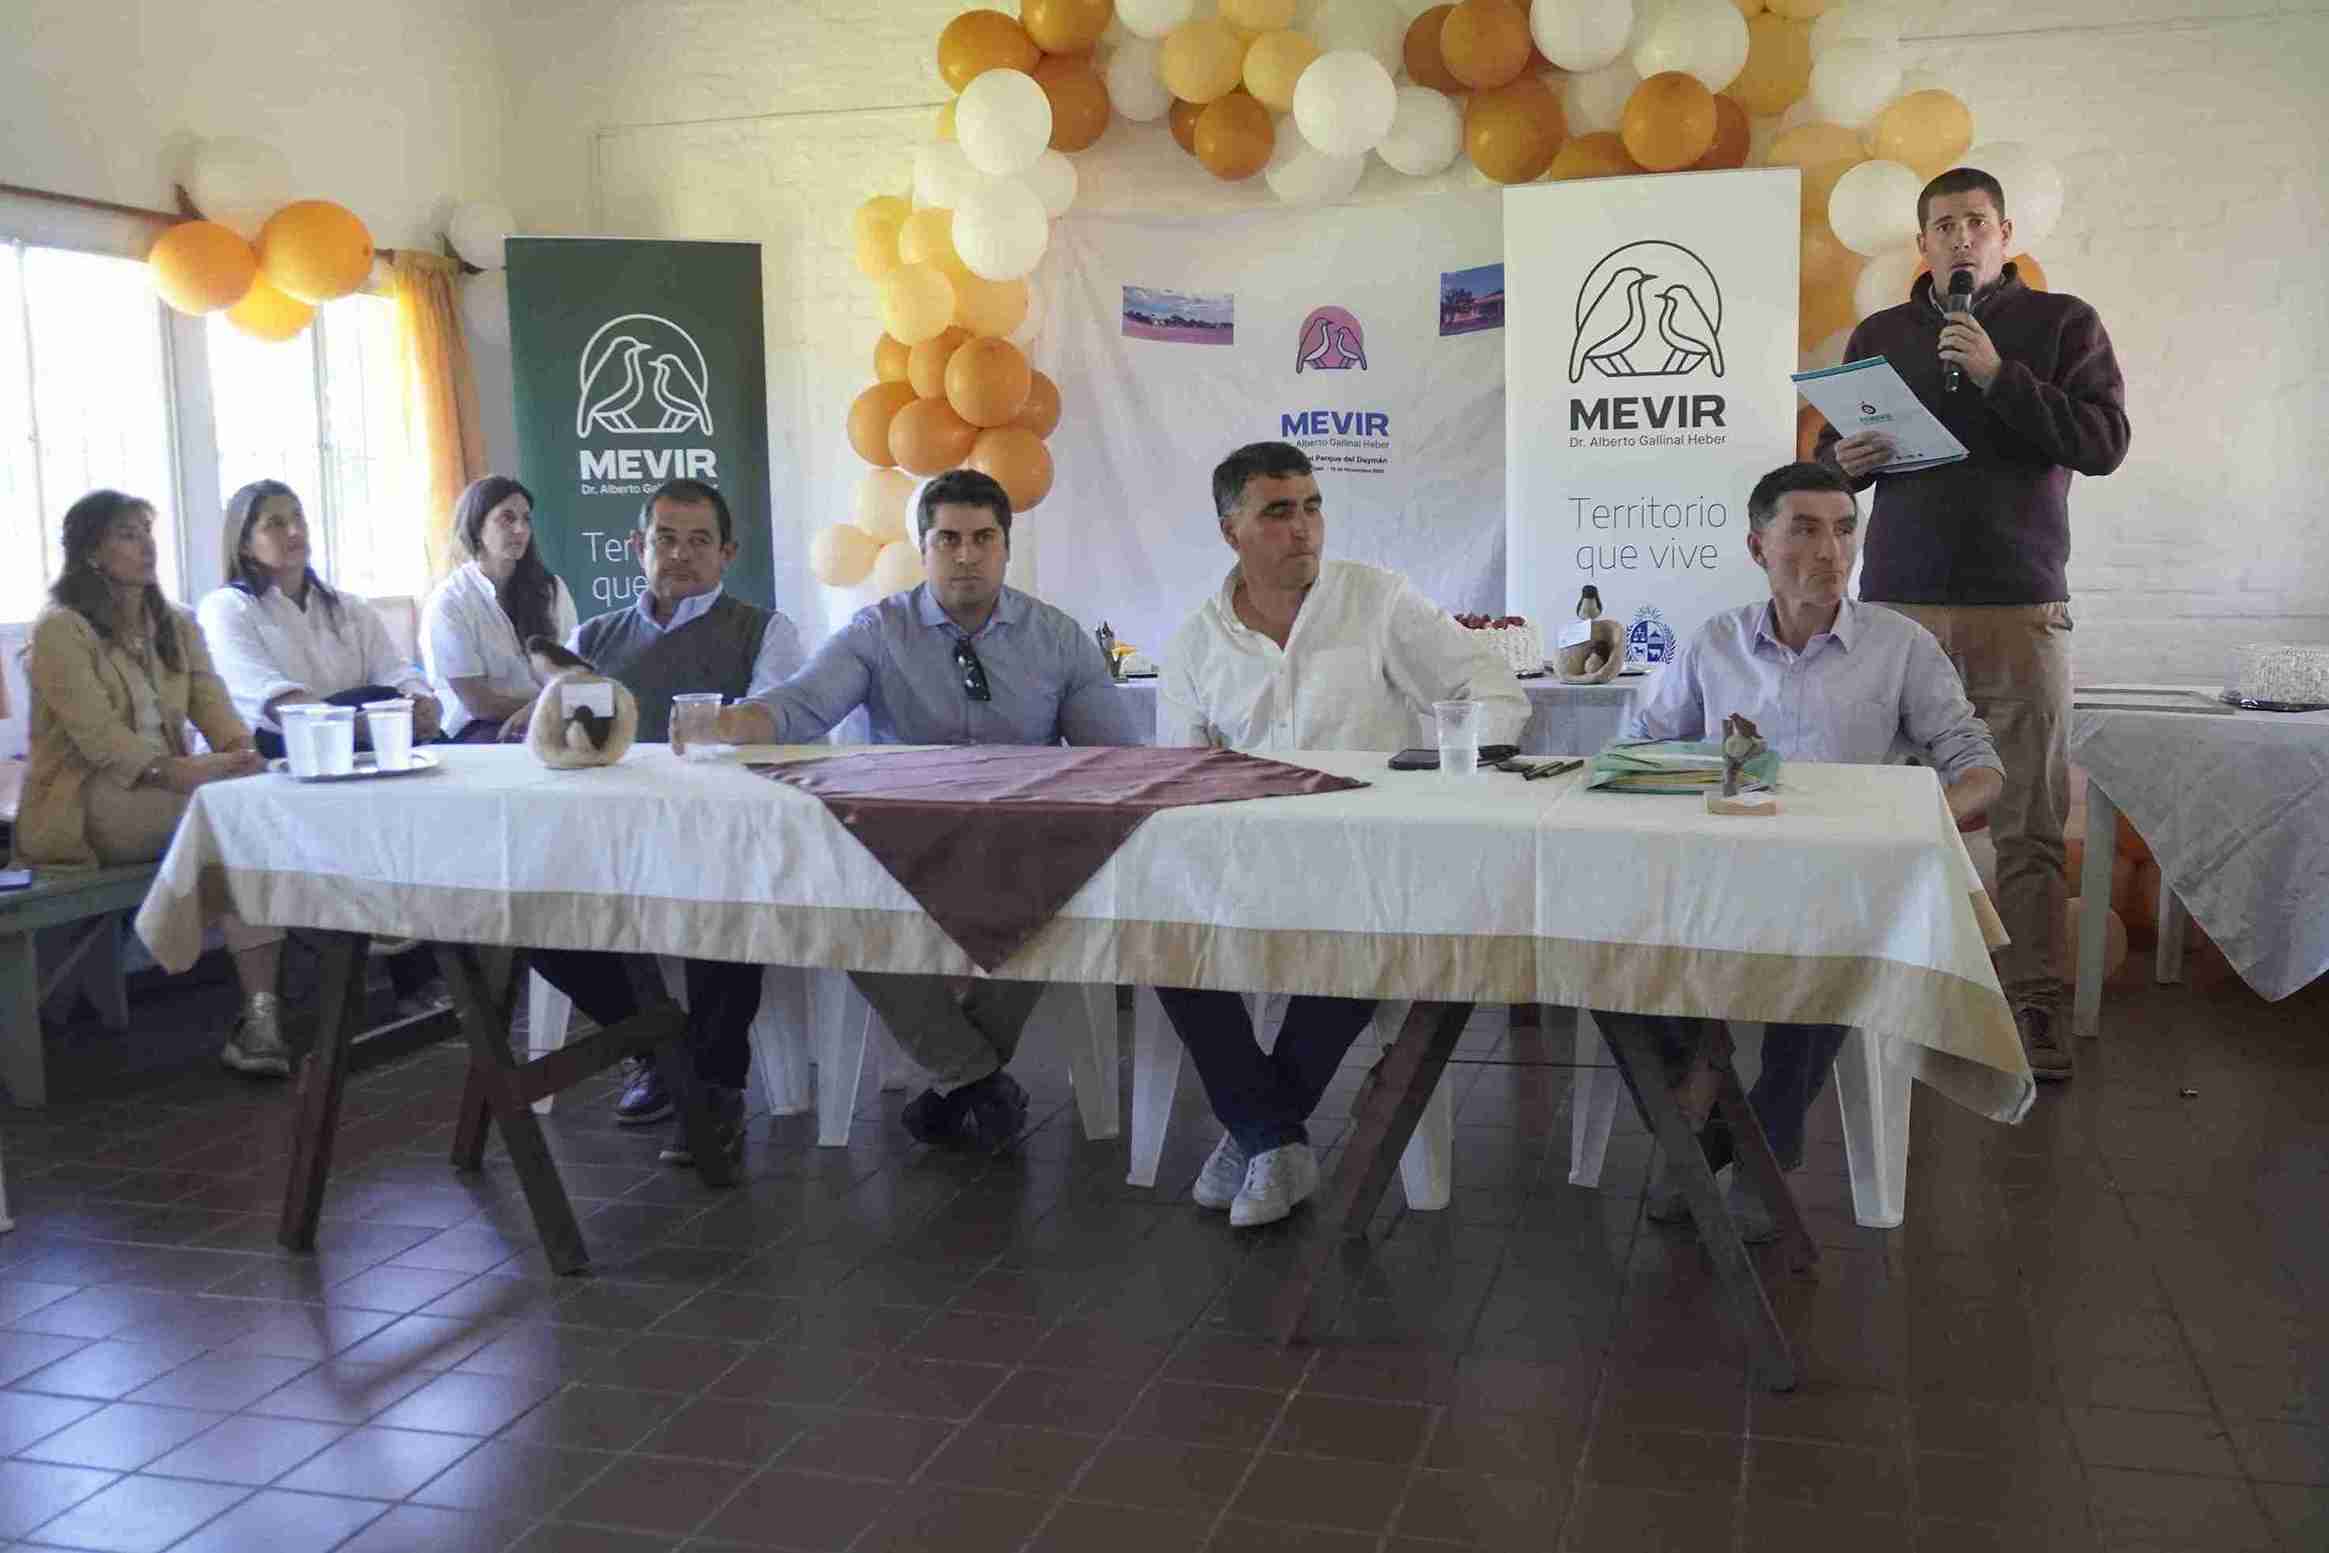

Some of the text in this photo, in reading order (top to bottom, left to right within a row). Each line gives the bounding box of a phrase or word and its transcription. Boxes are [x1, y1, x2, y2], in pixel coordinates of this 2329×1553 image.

[1281, 411, 1389, 437] MEVIR
[1570, 395, 1726, 431] MEVIR
[1363, 440, 1389, 449] Heber
[1570, 433, 1726, 448] Dr. Alberto Gallinal Heber
[579, 449, 718, 480] MEVIR
[581, 484, 597, 495] Dr.
[599, 484, 640, 494] Alberto
[1567, 495, 1727, 529] Territorio
[1576, 537, 1718, 577] que vive
[592, 575, 649, 608] que
